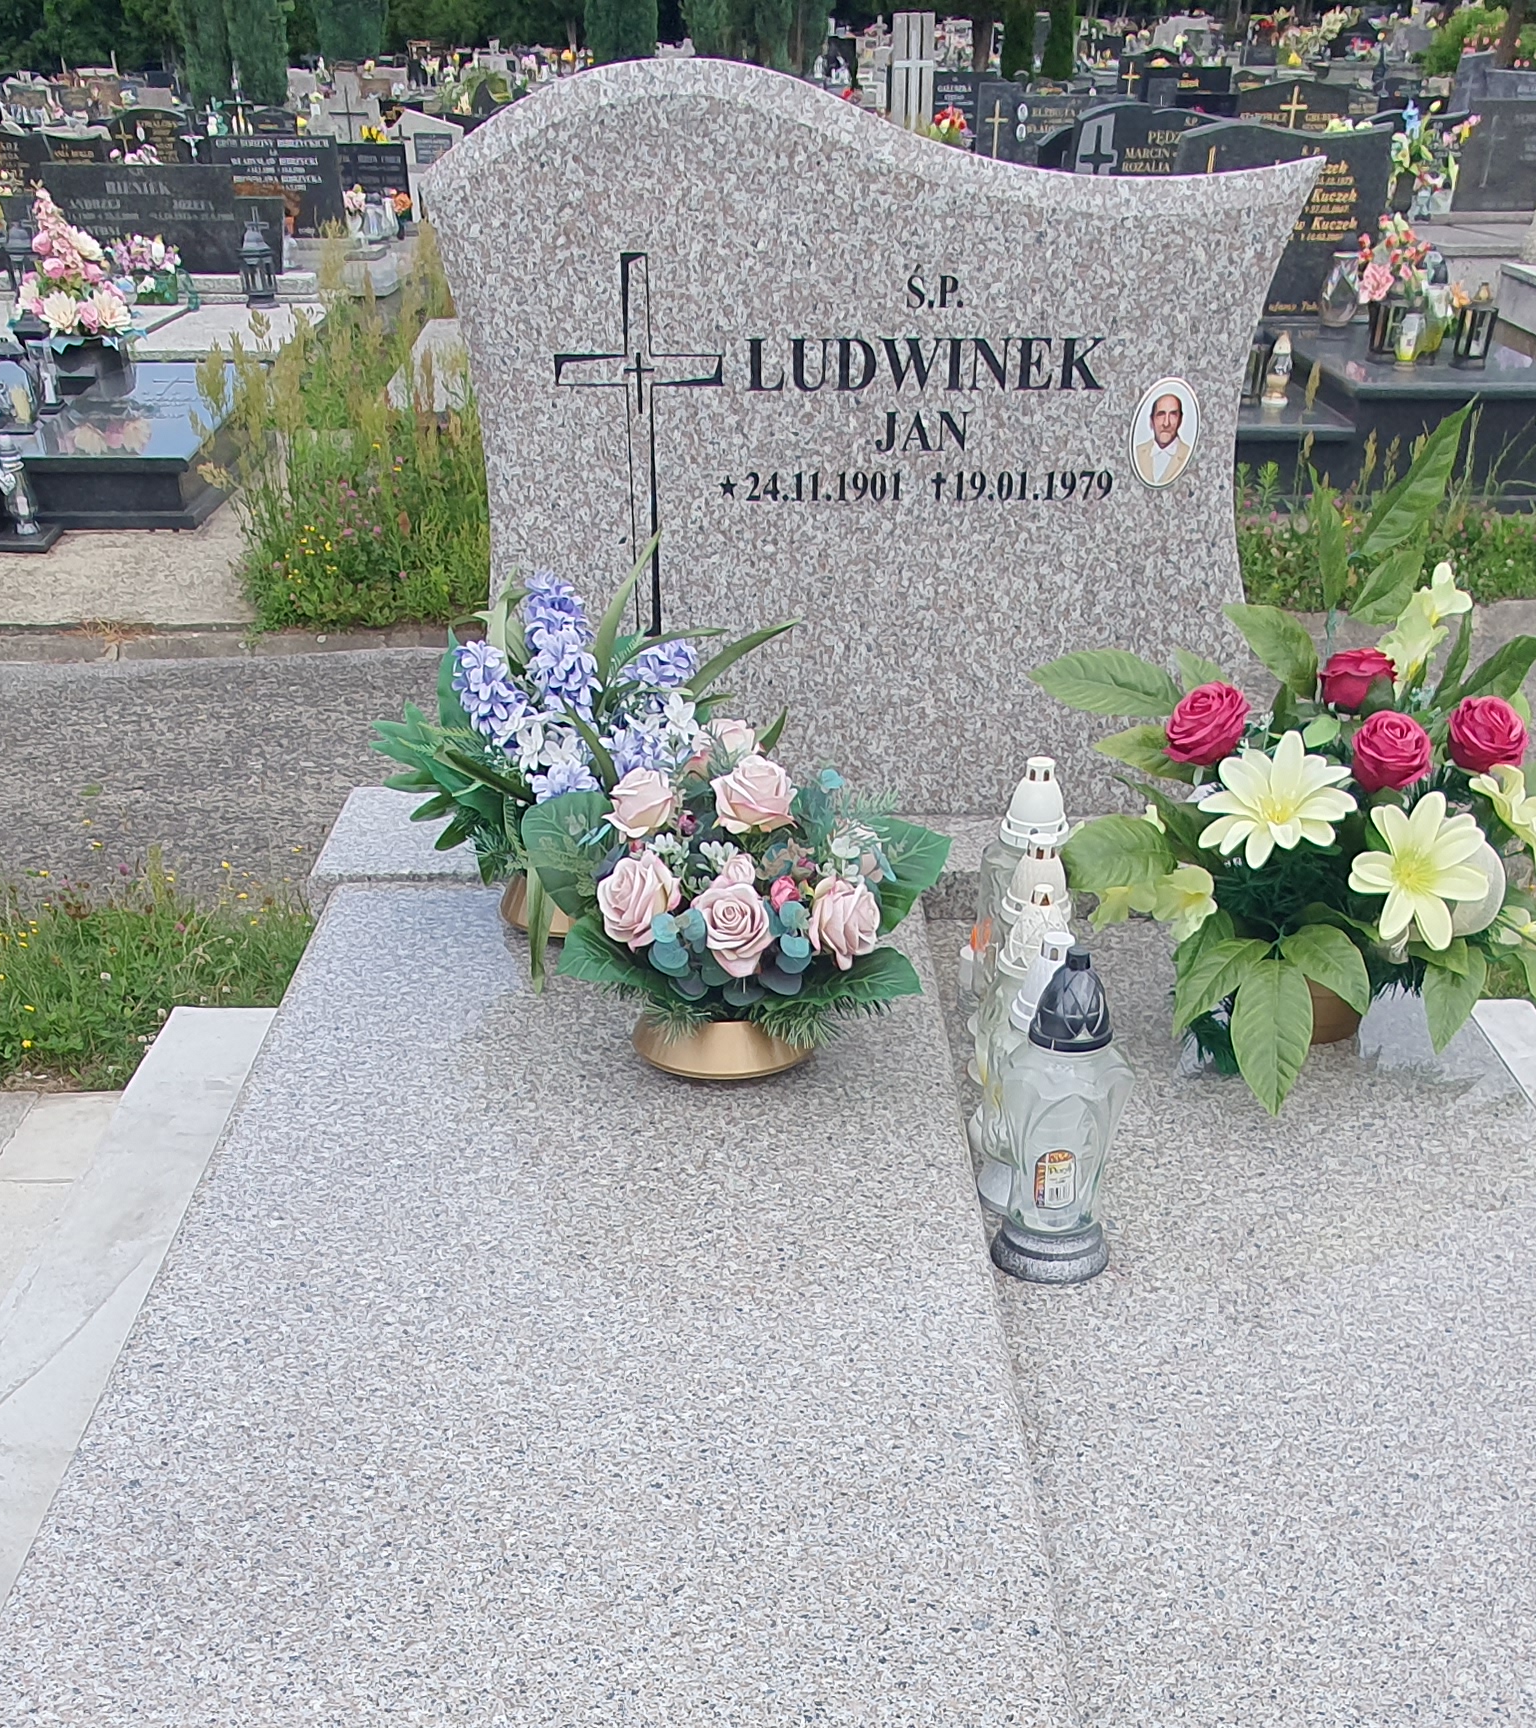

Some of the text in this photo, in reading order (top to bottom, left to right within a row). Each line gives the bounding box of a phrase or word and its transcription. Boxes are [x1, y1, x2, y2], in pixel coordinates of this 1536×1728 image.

[1125, 147, 1171, 159] MARCIN
[905, 263, 965, 309] Ś.P.
[744, 336, 1106, 393] LUDWINEK
[874, 410, 971, 454] JAN
[744, 470, 1114, 502] 24.11.1901 19.01.1979
